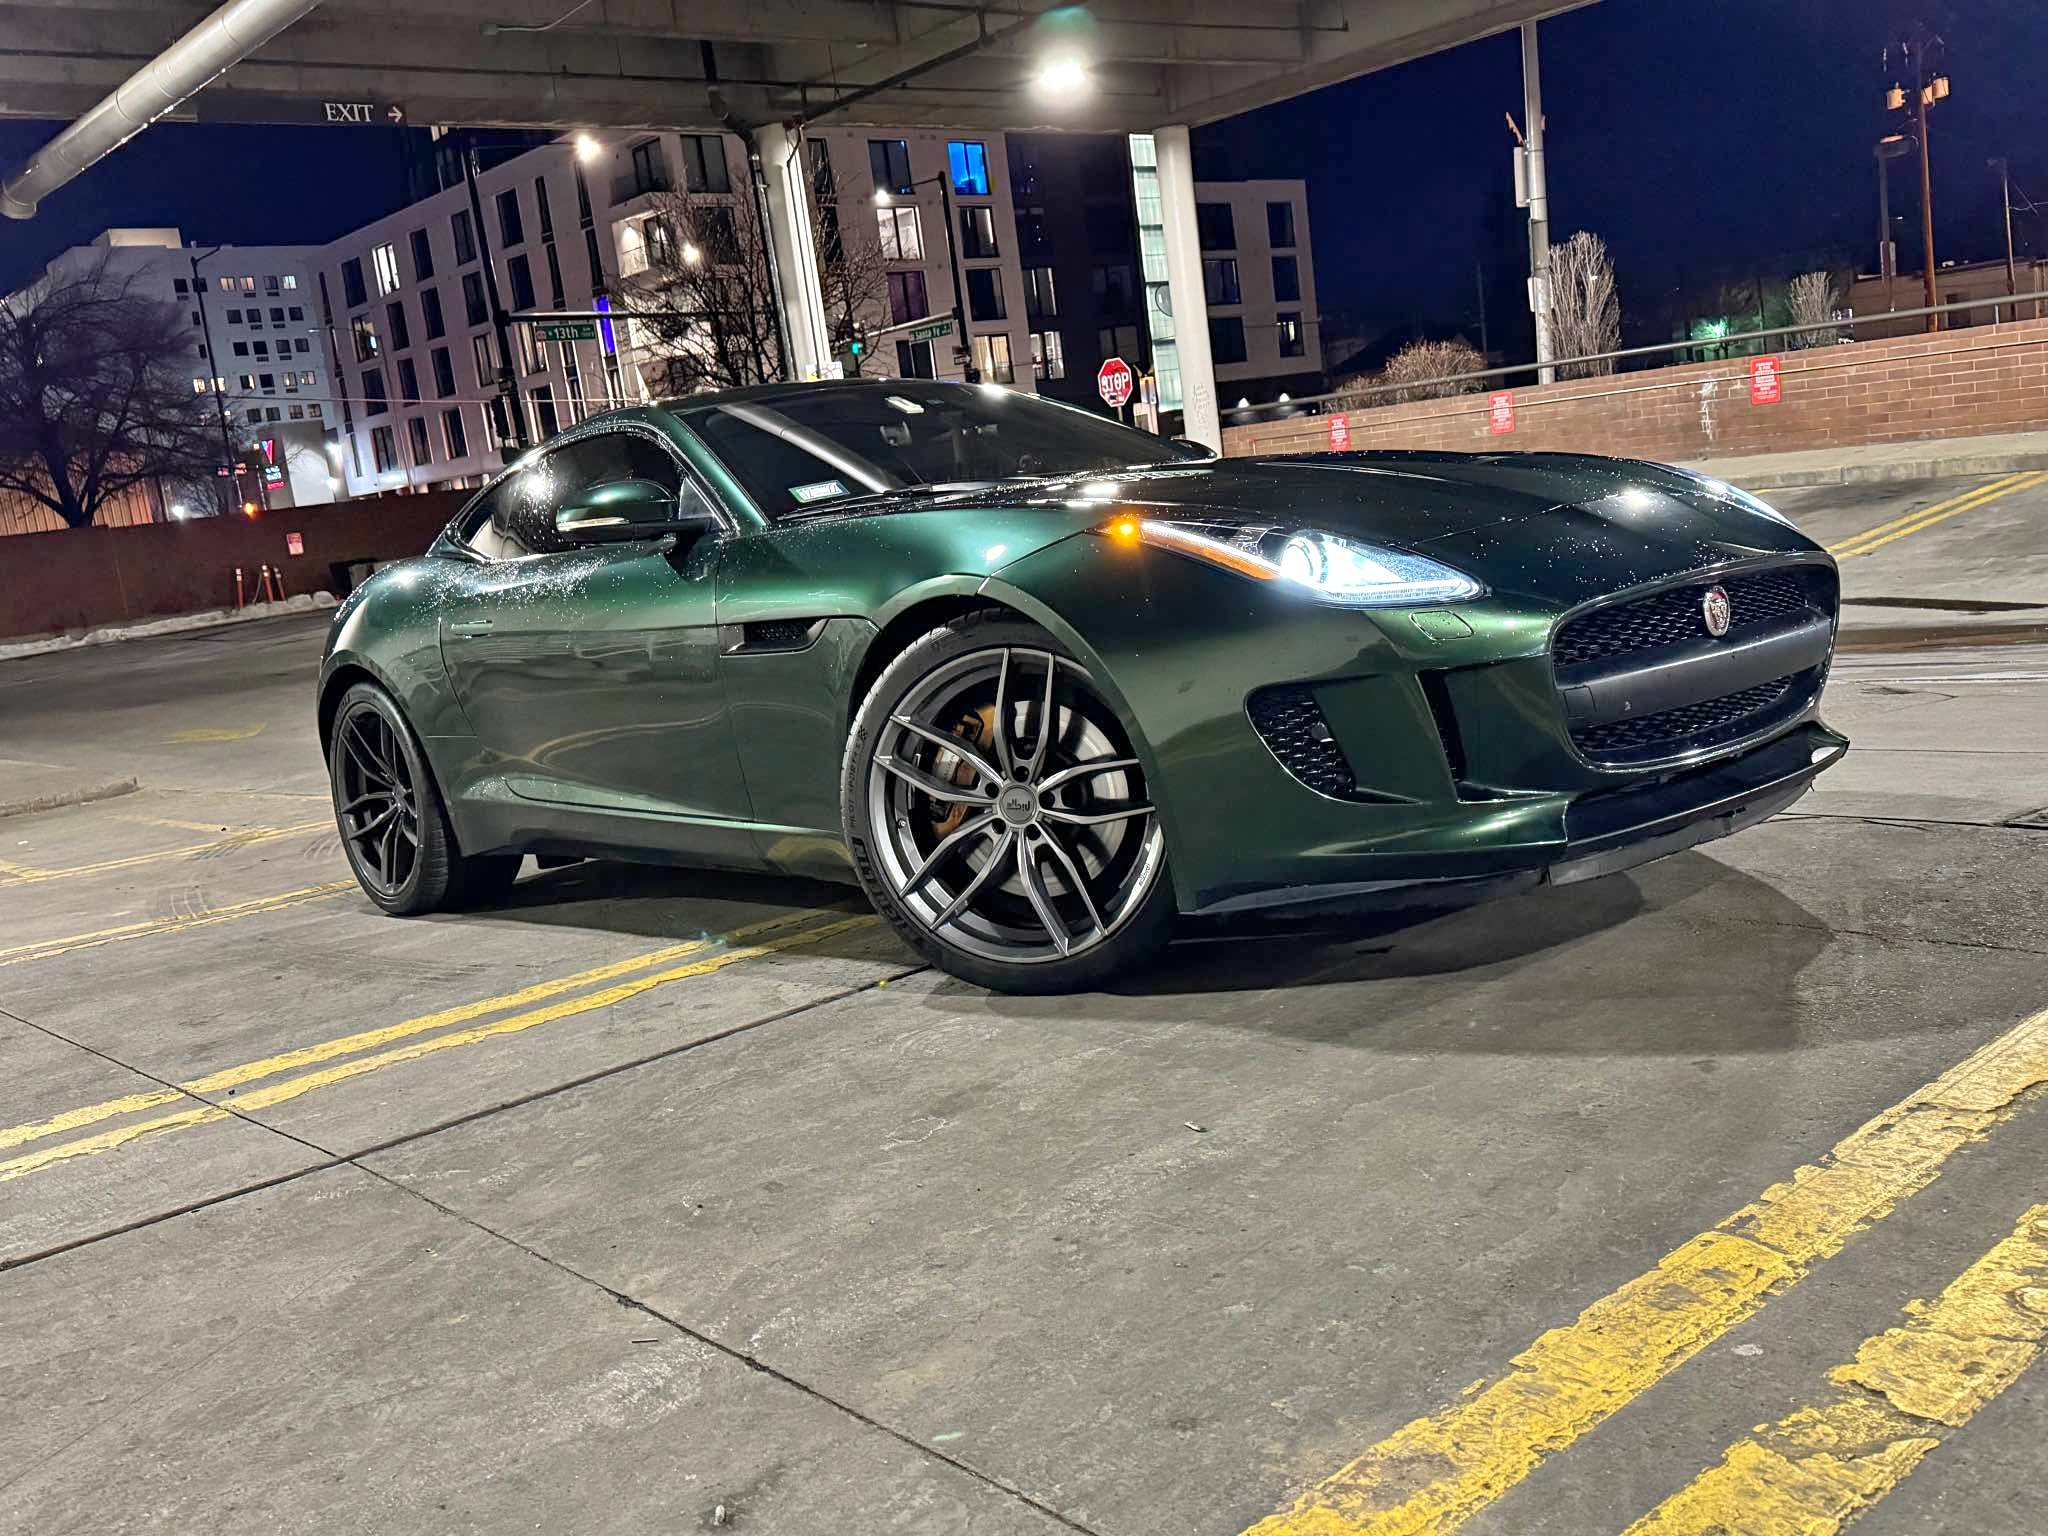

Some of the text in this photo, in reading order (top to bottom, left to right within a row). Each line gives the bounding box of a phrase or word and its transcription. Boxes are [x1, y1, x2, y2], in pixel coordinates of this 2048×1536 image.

[325, 103, 374, 122] EXIT
[553, 326, 579, 339] 13th
[1101, 372, 1129, 393] STOP
